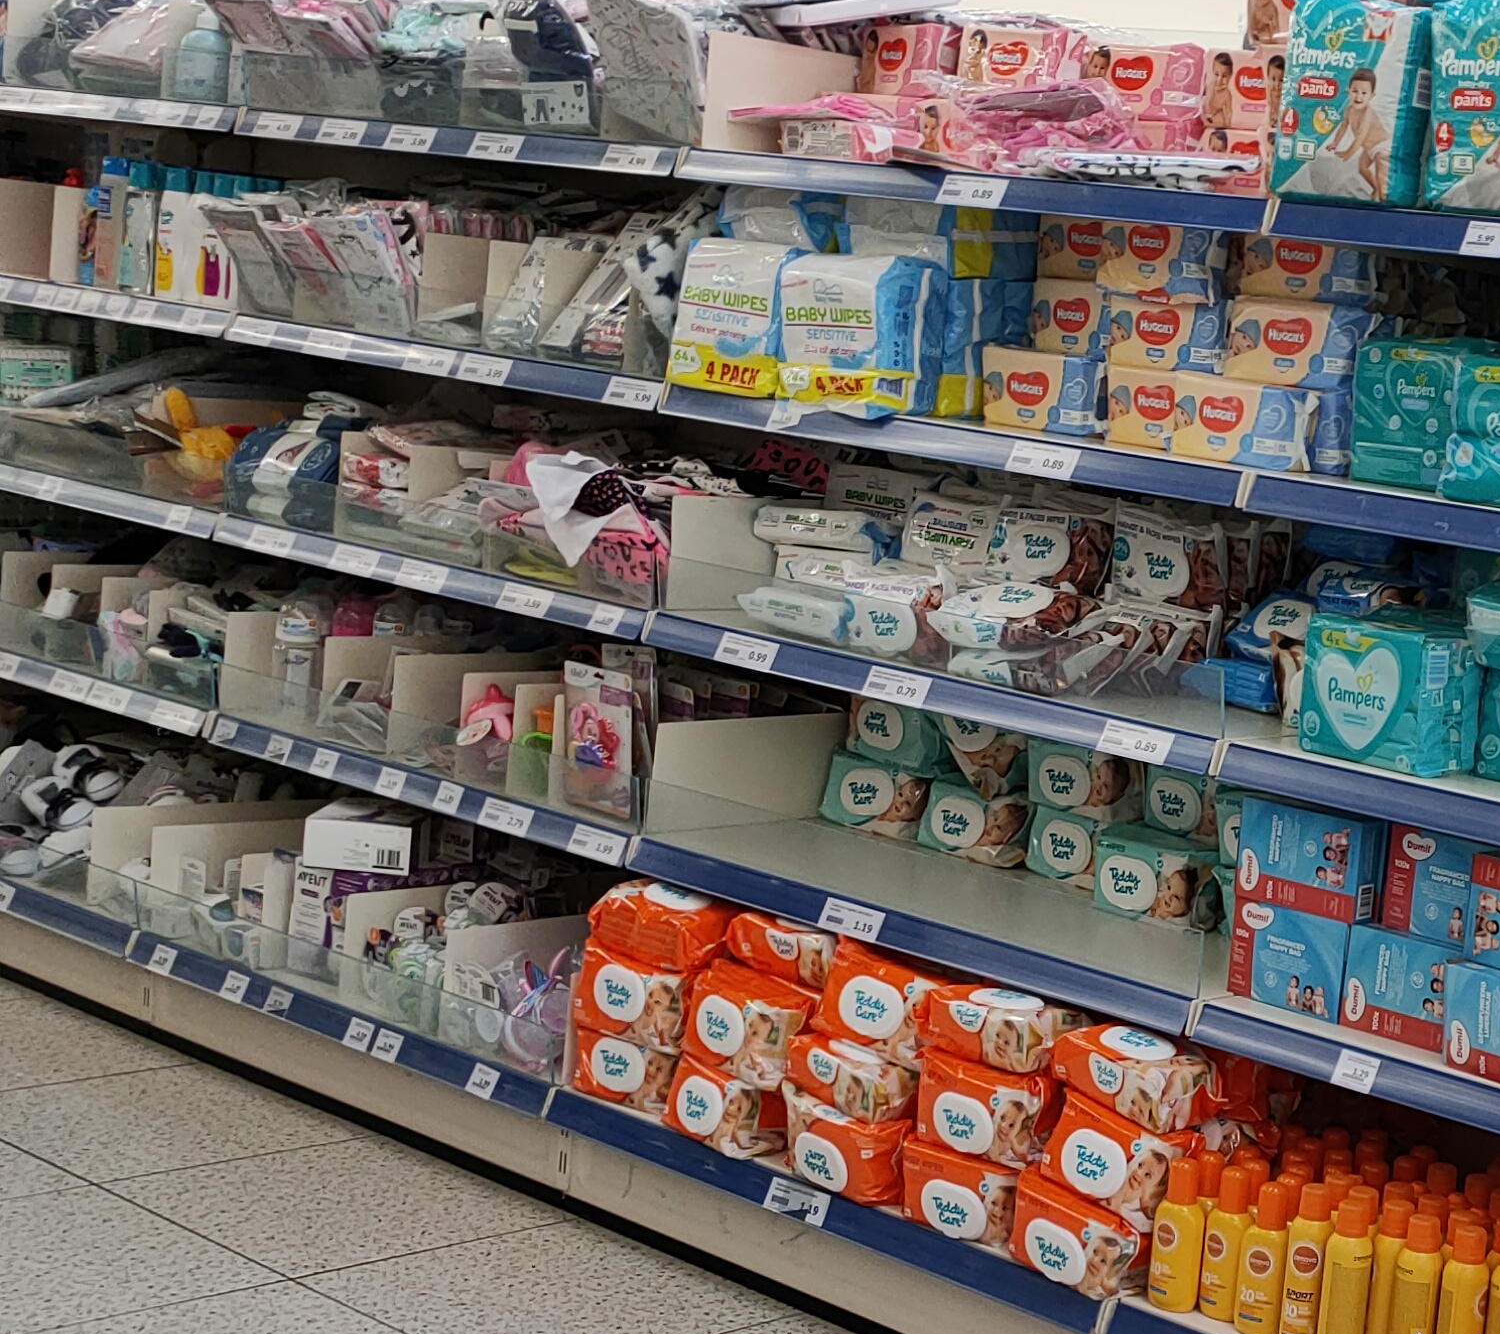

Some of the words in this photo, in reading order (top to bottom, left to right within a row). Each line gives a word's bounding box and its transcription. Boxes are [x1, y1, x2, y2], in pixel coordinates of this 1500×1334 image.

[1292, 38, 1357, 69] Pampers
[1113, 66, 1150, 82] HUGGIES
[1299, 81, 1336, 98] pants
[1453, 92, 1493, 110] pants
[1132, 233, 1166, 249] HUGGIES
[1279, 247, 1317, 264] HUGGIES
[683, 285, 721, 308] BABY
[723, 293, 769, 314] WIPES
[785, 306, 823, 323] BABY
[824, 308, 873, 325] WIPES
[1056, 307, 1086, 323] HUGGIES
[1139, 319, 1175, 335] HUGGIES
[1267, 327, 1306, 345] HUGGIES
[719, 362, 761, 387] PACK
[1010, 379, 1044, 397] HUGGIES
[1396, 378, 1437, 399] Pampers
[1137, 393, 1171, 411] HUGGIES
[1202, 405, 1238, 423] HUGGIES
[1041, 457, 1065, 471] 0.89
[1022, 534, 1056, 552] Teddy
[1144, 552, 1176, 571] Teddy
[868, 610, 900, 631] Teddy
[895, 685, 919, 699] 0.79
[1327, 676, 1387, 712] Pampers
[1133, 740, 1159, 754] 0.89
[1045, 768, 1077, 786] Teddy
[848, 781, 880, 799] Teddy
[1155, 788, 1188, 810] Teddy
[940, 808, 972, 829] Teddy
[1049, 832, 1078, 852] Teddy
[1407, 839, 1433, 854] Dumil
[1109, 866, 1142, 887] Teddy
[1245, 854, 1254, 886] Dumil
[1111, 881, 1136, 896] Care
[1246, 909, 1271, 924] Dumil
[851, 919, 874, 935] 1.19
[604, 979, 633, 1002] Teddy
[1351, 983, 1360, 1015] Dumil
[606, 993, 629, 1009] Care
[854, 989, 889, 1017] Teddy
[705, 1010, 731, 1035] Teddy
[855, 1007, 880, 1024] Care
[706, 1026, 726, 1043] Care
[1456, 1027, 1465, 1060] Dumil
[600, 1049, 631, 1072] Teddy
[604, 1063, 628, 1079] Care
[685, 1090, 709, 1114] Teddy
[685, 1105, 705, 1122] Care
[942, 1108, 976, 1137] Teddy
[947, 1124, 972, 1140] Care
[1075, 1144, 1110, 1174] Teddy
[1076, 1162, 1100, 1182] Care
[931, 1195, 968, 1224] Teddy
[937, 1212, 965, 1229] Care
[1035, 1236, 1070, 1266] Teddy
[1039, 1254, 1064, 1272] Care
[1239, 1289, 1255, 1303] 20
[1286, 1287, 1315, 1300] SPORT
